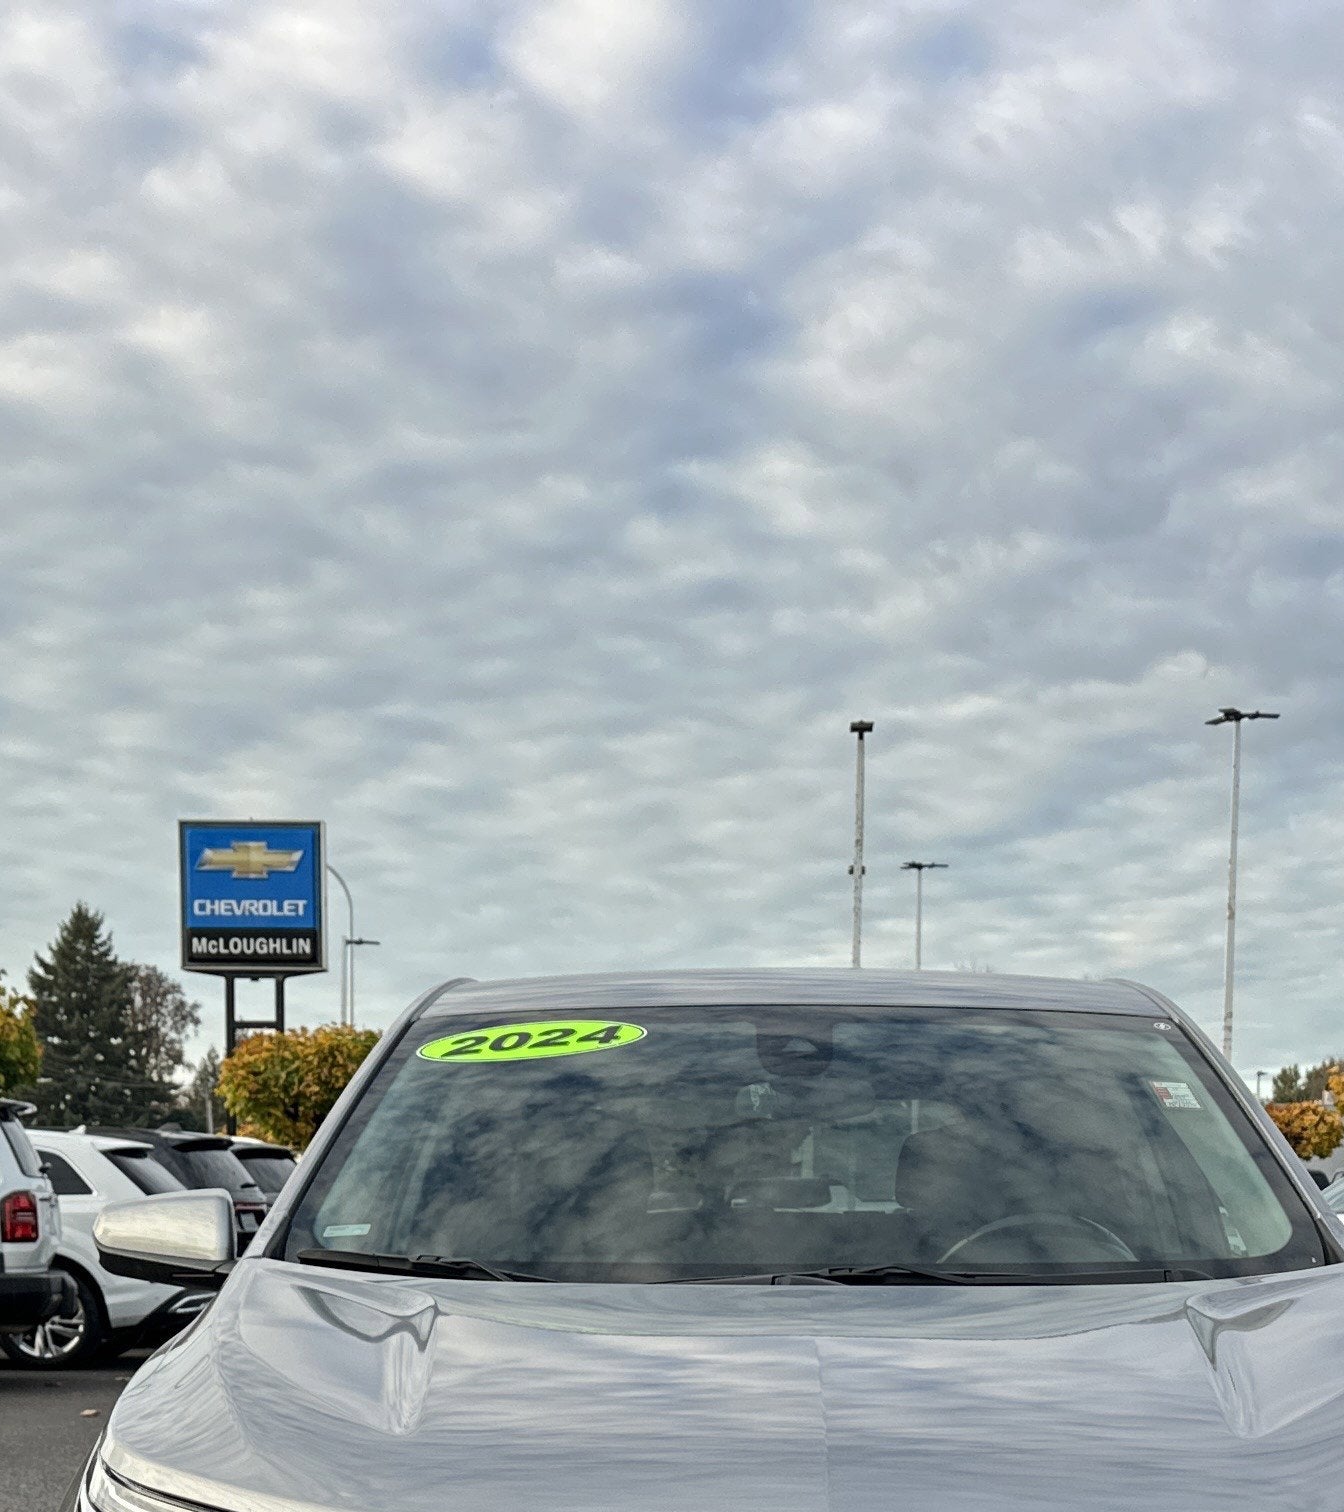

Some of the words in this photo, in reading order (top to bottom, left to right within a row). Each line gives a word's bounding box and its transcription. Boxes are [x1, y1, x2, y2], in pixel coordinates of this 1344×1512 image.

[193, 899, 307, 917] CHEVROLET
[191, 937, 311, 954] McLOUGHLIN
[441, 1024, 624, 1058] 2024
